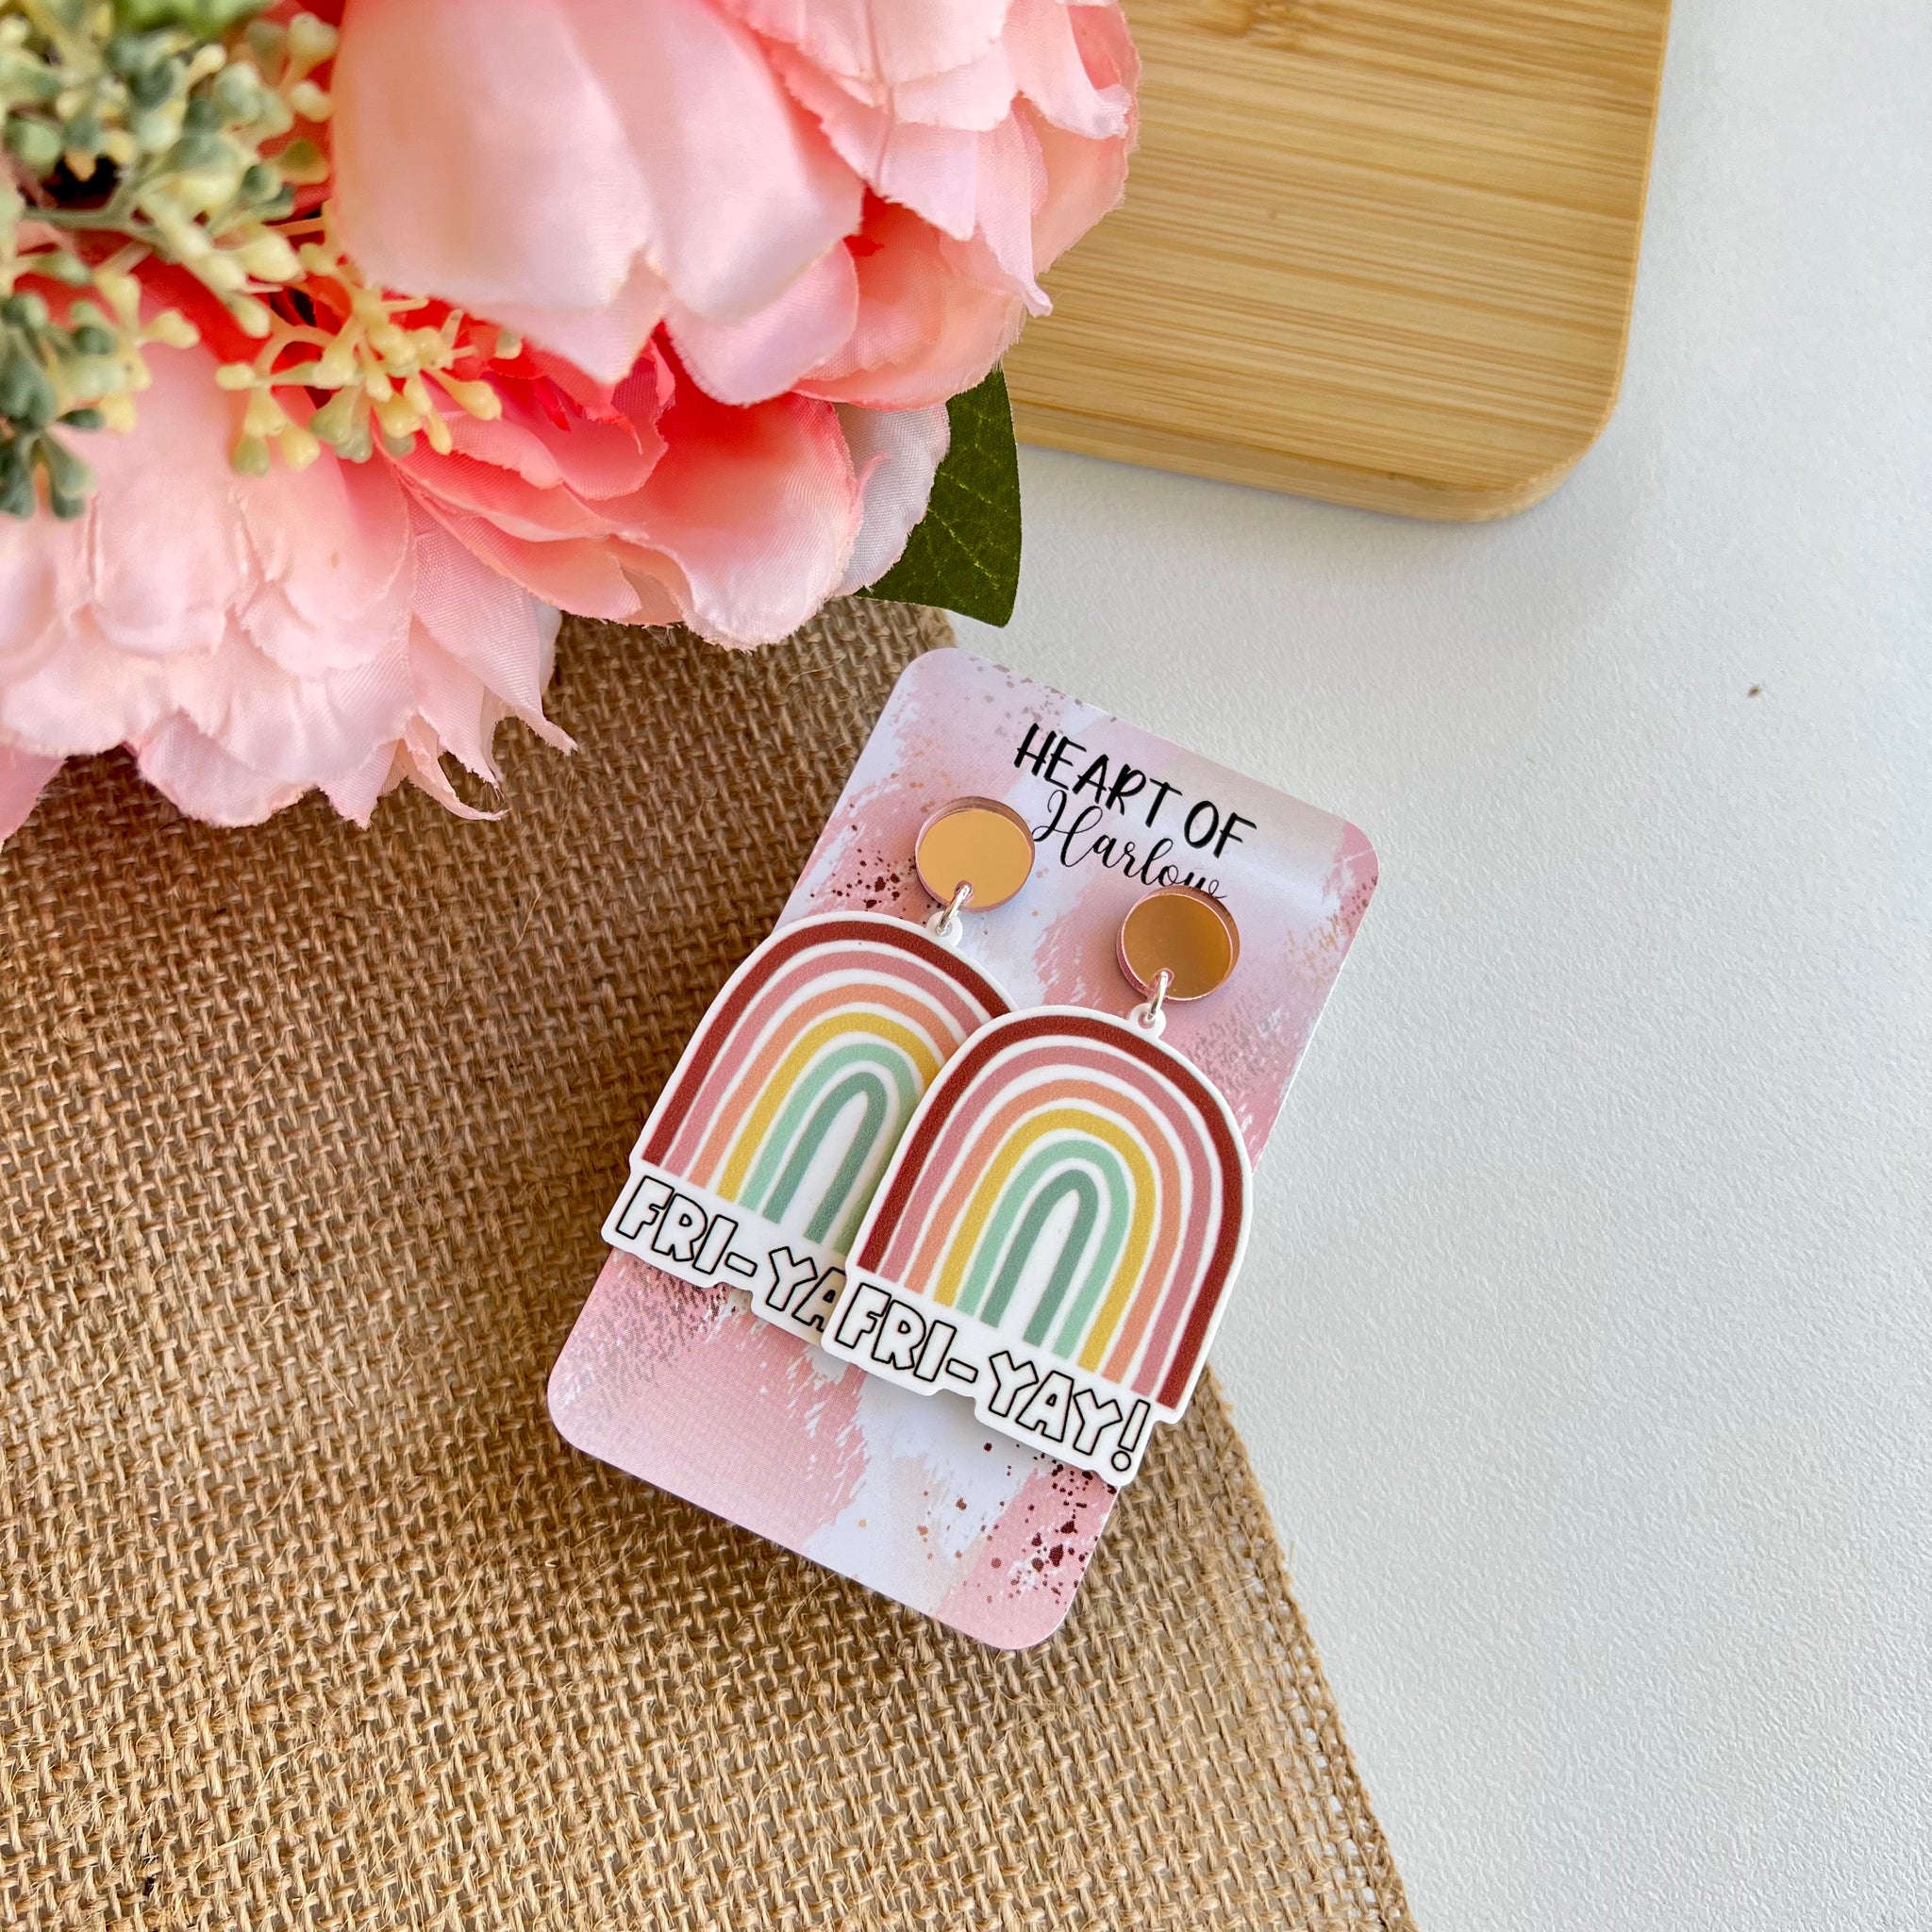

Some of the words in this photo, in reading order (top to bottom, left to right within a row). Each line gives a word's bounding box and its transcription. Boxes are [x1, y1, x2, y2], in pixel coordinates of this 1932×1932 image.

[1013, 722, 1183, 828] HEART
[1183, 800, 1257, 858] OF
[1031, 789, 1228, 899] Harlow
[615, 1174, 847, 1333] FRI-YA
[834, 1282, 1151, 1472] FRI-YAY!
